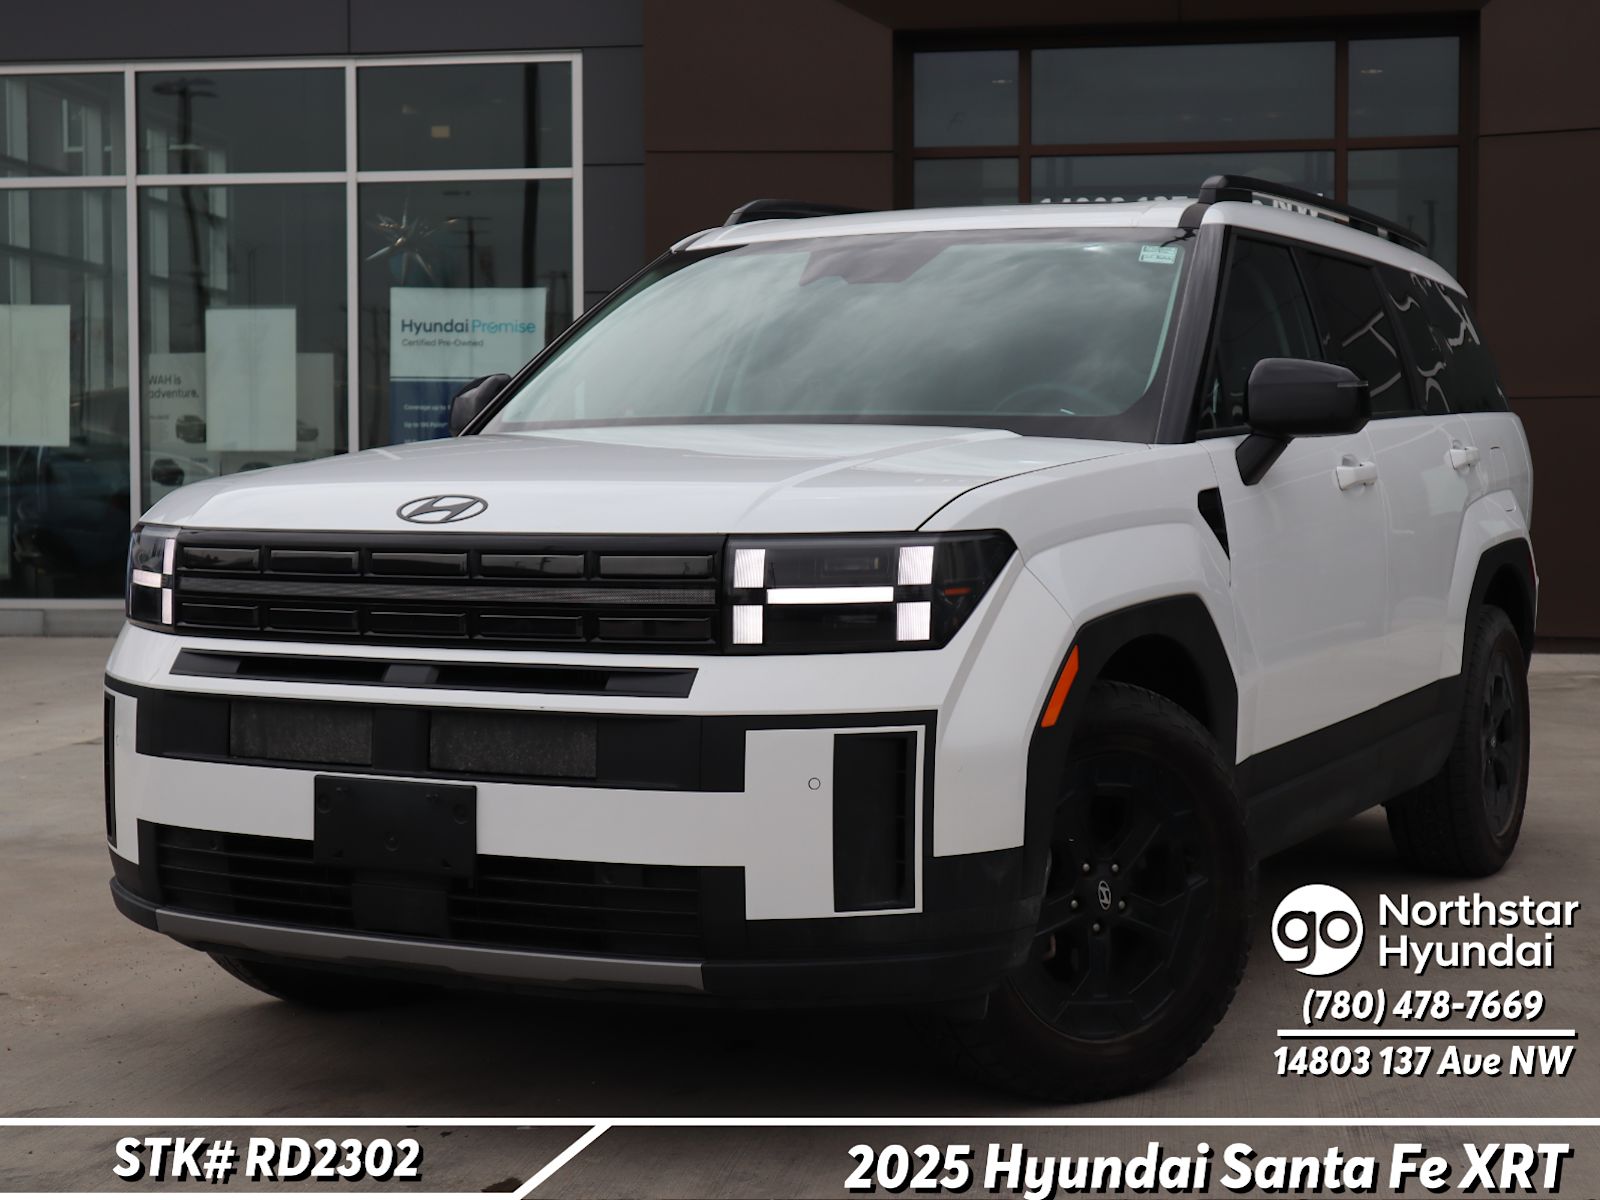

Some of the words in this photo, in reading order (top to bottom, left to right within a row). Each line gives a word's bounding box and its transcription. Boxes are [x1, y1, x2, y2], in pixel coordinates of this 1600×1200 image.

[401, 319, 469, 335] Hyundai
[471, 319, 537, 334] Promise
[402, 338, 436, 348] Certified
[438, 338, 484, 348] Pre-Owned
[173, 374, 182, 385] is
